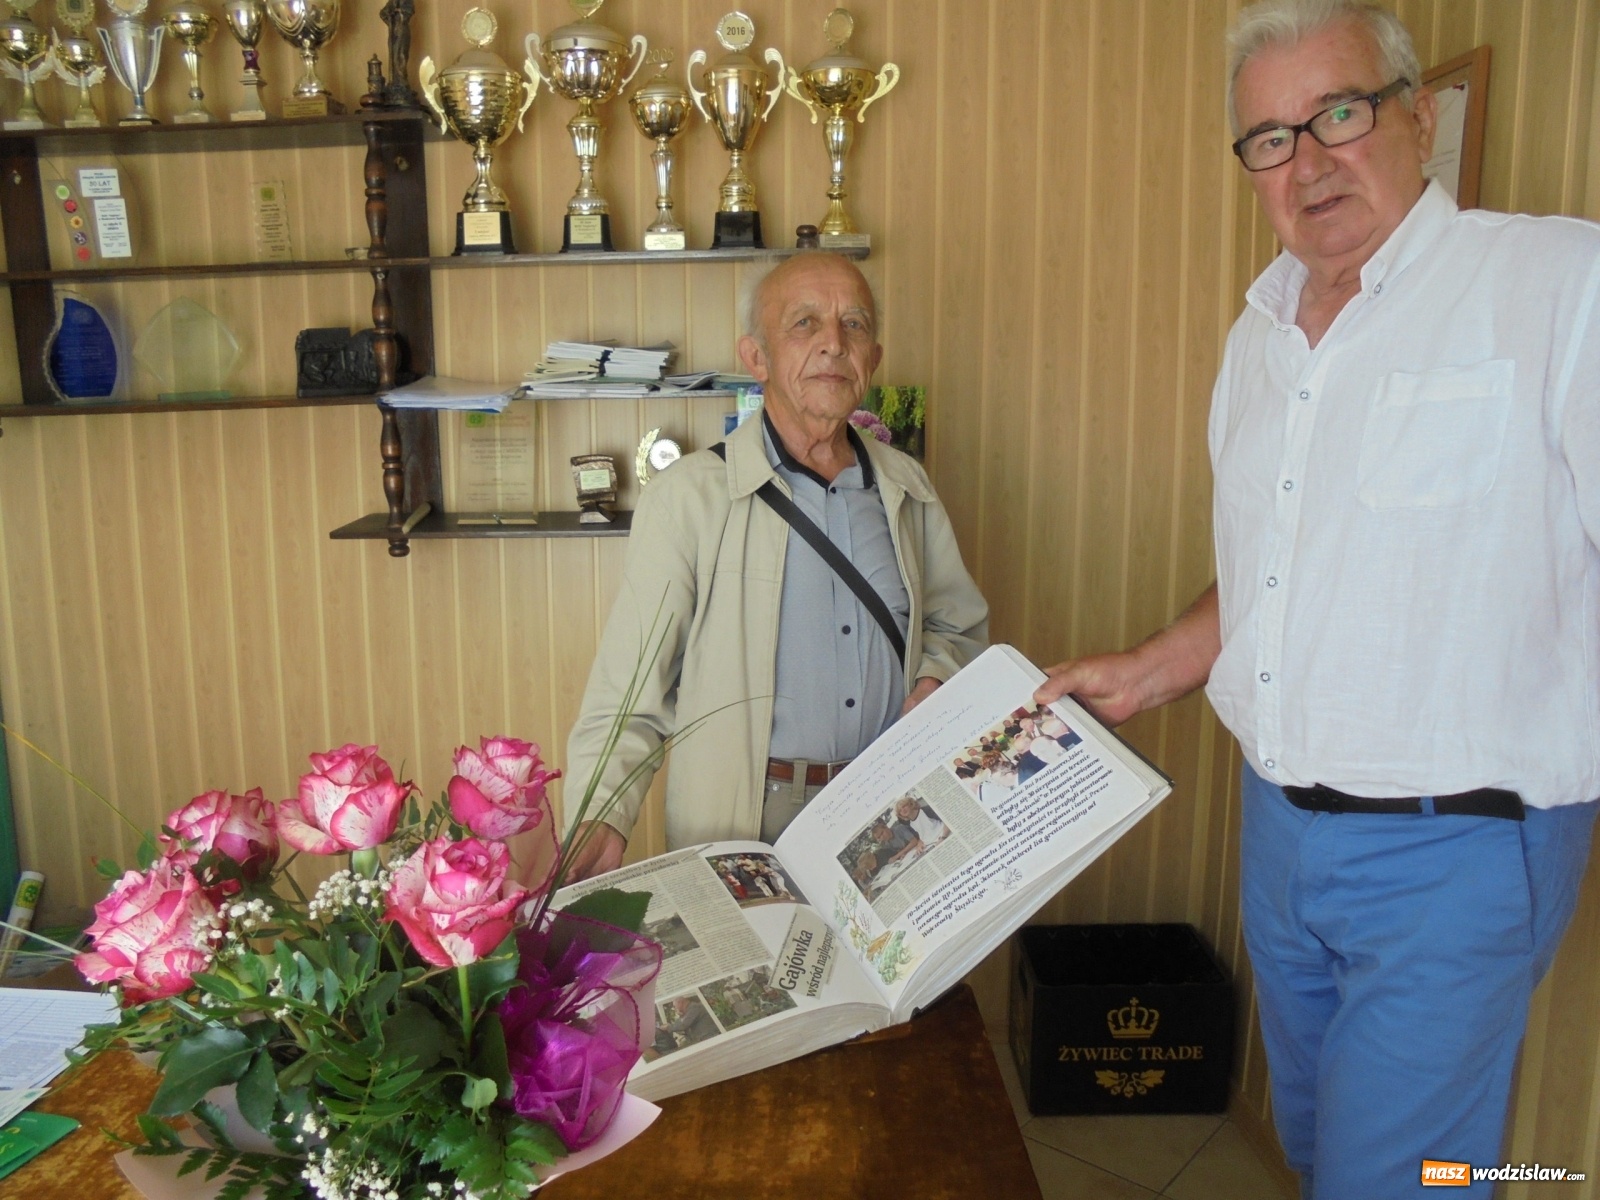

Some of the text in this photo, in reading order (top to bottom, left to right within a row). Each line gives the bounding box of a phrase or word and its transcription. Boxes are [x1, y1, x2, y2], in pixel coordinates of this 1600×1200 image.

[727, 26, 746, 36] 2016
[1007, 821, 1023, 833] były
[1070, 765, 1104, 793] jubileuszem
[1035, 776, 1060, 794] sierpnia
[1069, 755, 1090, 771] terenie
[1047, 776, 1073, 794] Pszowie
[932, 875, 960, 899] istnienia
[960, 866, 974, 877] tego
[1008, 814, 1047, 843] uroczystości
[1054, 792, 1080, 814] przybyli
[1080, 769, 1113, 795] senatorowie
[916, 900, 942, 925] posłowie
[1000, 843, 1020, 860] miast
[1020, 826, 1046, 846] naszego
[1046, 805, 1071, 829] regionu
[918, 910, 943, 932] naszego
[943, 892, 968, 911] ogrodu
[1007, 845, 1033, 866] odebrał
[1034, 838, 1044, 848] list
[1044, 809, 1088, 843] gratulacyjny
[779, 930, 813, 991] Gajówka
[807, 965, 825, 998] wśród
[1058, 1045, 1203, 1061] ŻYWIEC TRADE
